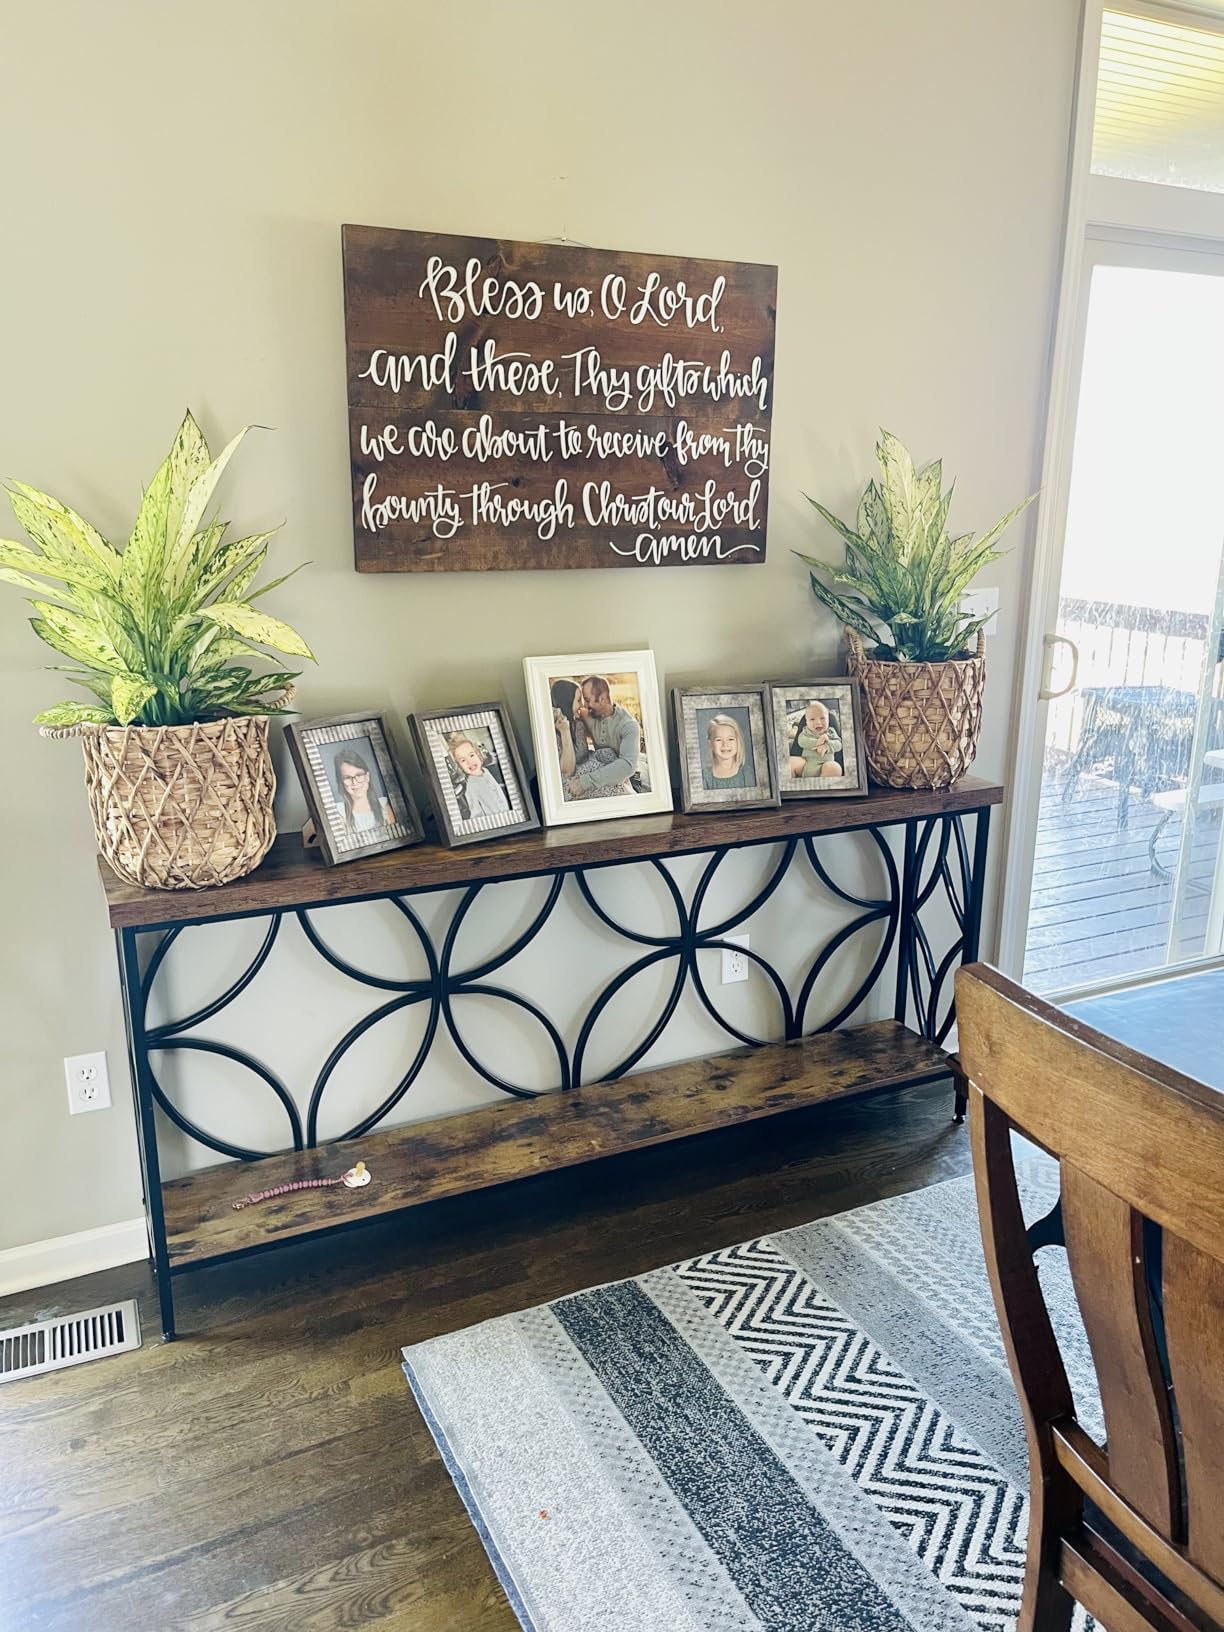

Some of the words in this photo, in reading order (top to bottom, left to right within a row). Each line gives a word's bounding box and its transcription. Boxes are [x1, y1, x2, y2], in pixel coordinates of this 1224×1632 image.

[419, 256, 545, 324] Bless
[553, 281, 594, 319] us,
[600, 273, 627, 320] O
[629, 272, 727, 334] Lord,
[358, 331, 456, 394] and
[462, 338, 563, 399] these,
[560, 346, 634, 412] Thy
[636, 352, 704, 413] gifts
[702, 349, 768, 411] which
[360, 424, 404, 462] we
[408, 420, 458, 462] are
[462, 414, 553, 462] about
[552, 419, 583, 460] to
[585, 424, 669, 460] receive
[672, 420, 732, 468] from
[657, 491, 697, 525] our
